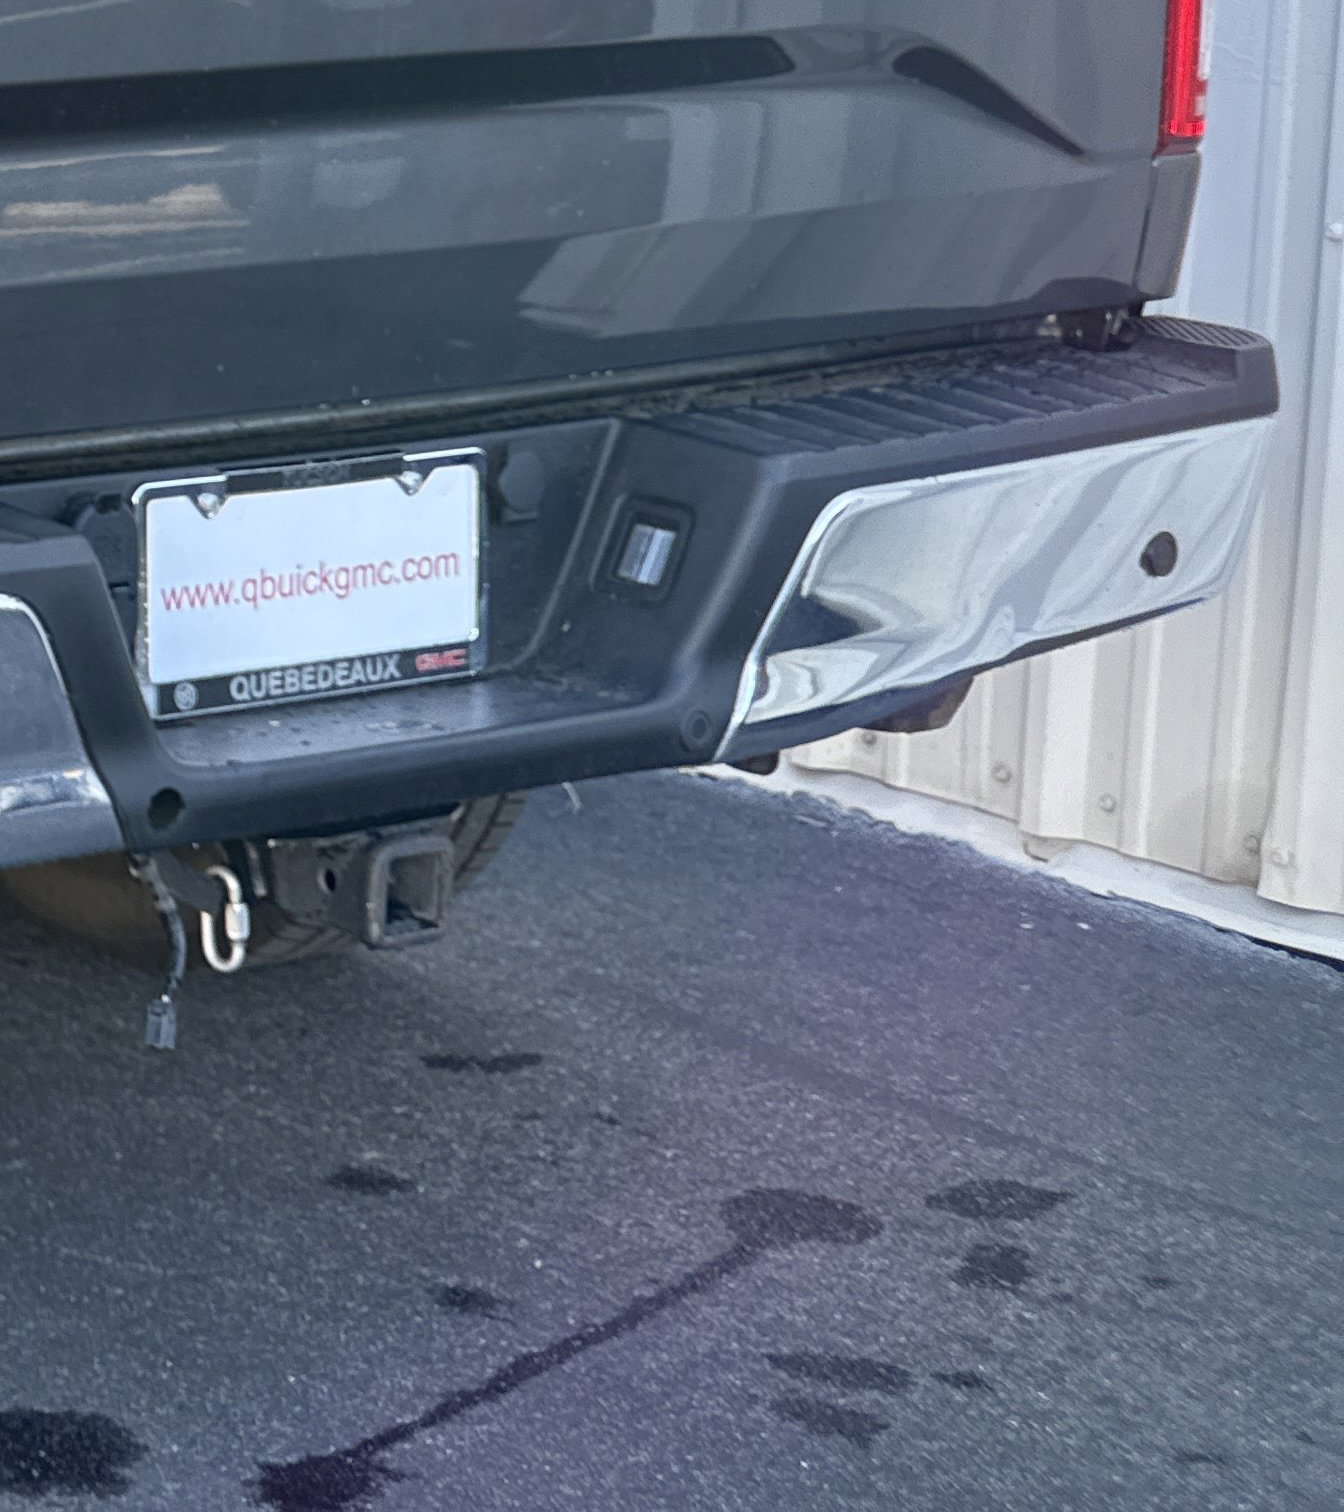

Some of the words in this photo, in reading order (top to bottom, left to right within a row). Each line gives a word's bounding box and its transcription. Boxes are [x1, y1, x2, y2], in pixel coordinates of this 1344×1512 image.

[160, 552, 460, 611] www.qbuickgmc.com
[229, 653, 401, 701] QUEBEDEAUX
[415, 648, 468, 673] GMC
